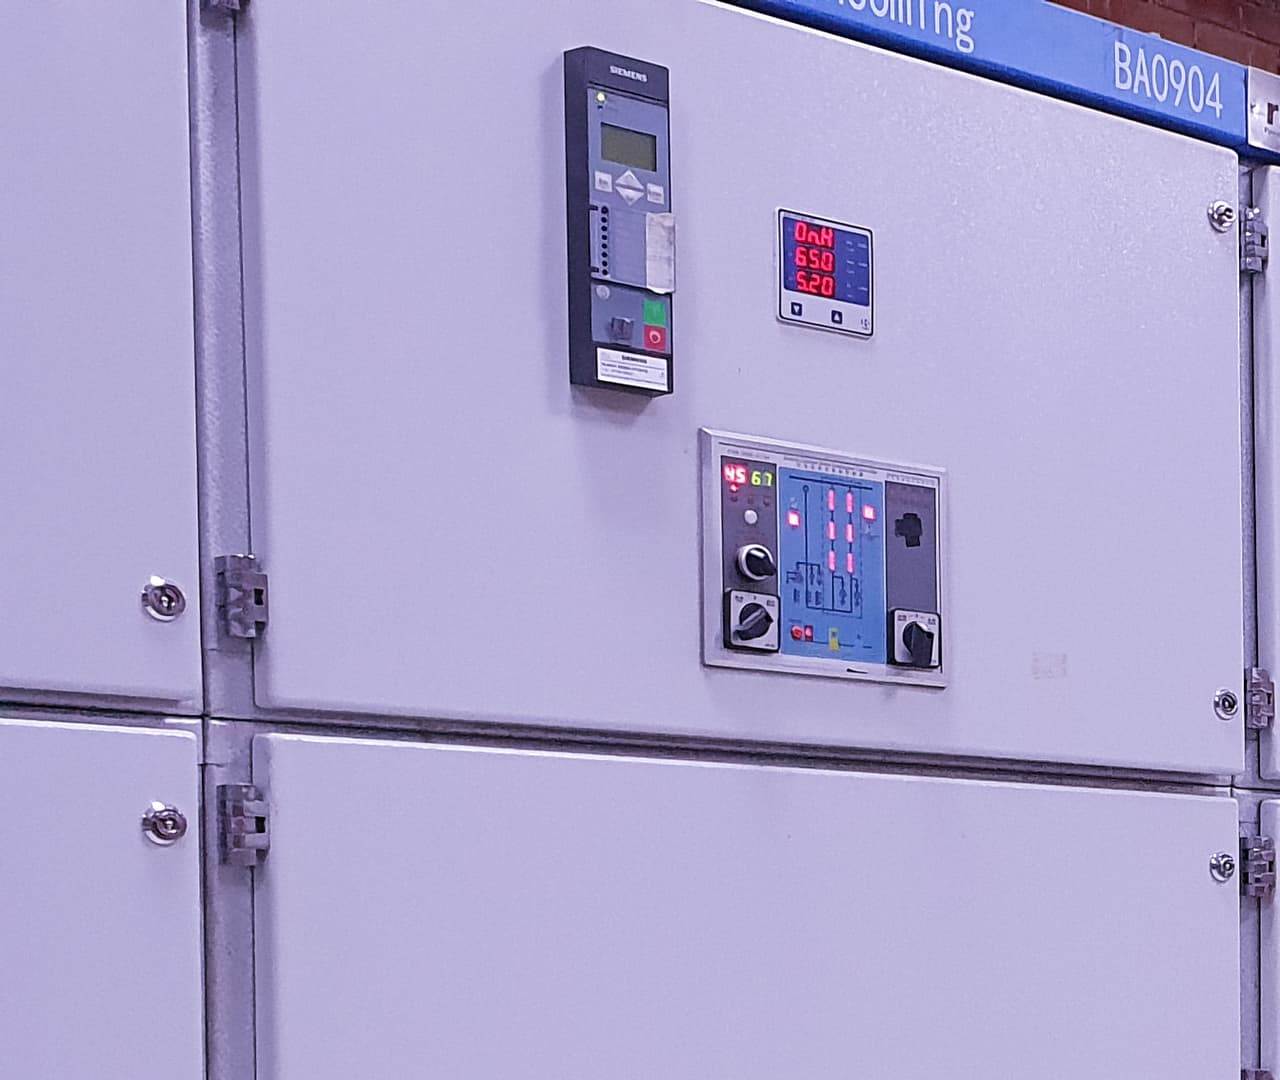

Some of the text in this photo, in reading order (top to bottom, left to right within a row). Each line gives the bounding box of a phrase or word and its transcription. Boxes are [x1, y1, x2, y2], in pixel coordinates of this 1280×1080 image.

[609, 65, 648, 83] SIEMENS
[1114, 41, 1223, 118] BA0904
[795, 246, 834, 271] 650
